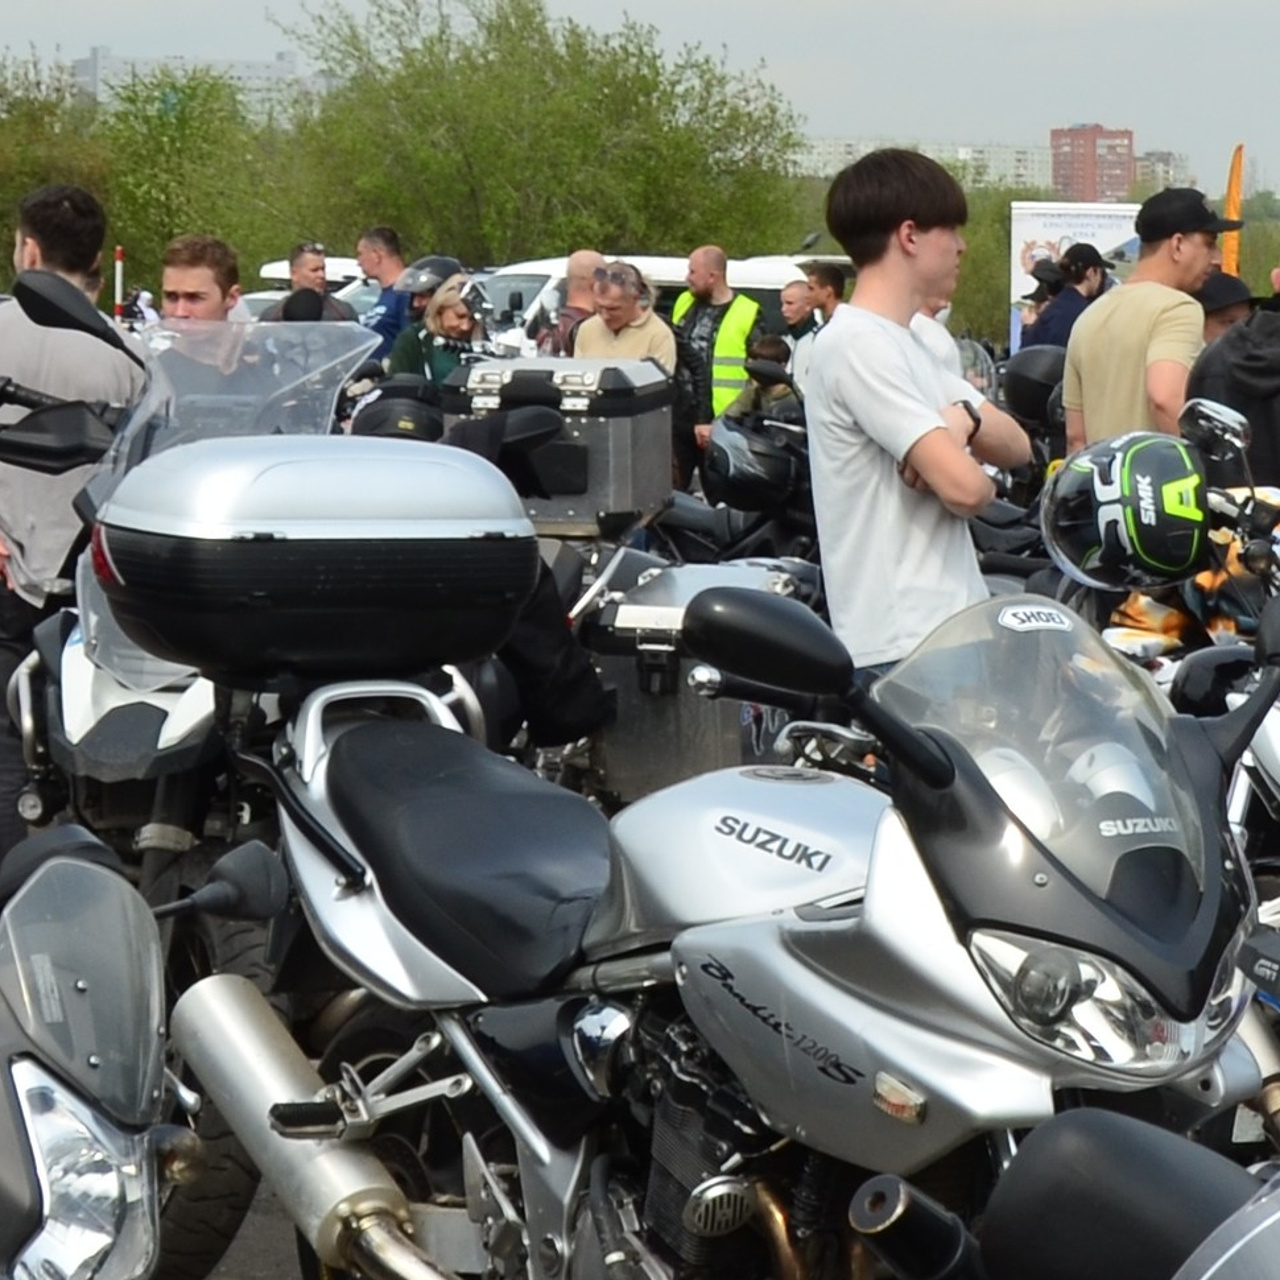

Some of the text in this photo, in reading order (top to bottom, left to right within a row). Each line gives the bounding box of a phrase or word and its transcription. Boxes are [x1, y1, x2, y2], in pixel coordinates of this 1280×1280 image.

[1135, 473, 1157, 527] SMK
[1010, 610, 1067, 626] SHOEI
[714, 815, 833, 873] SUZUKI
[1098, 817, 1179, 837] SUZUKI
